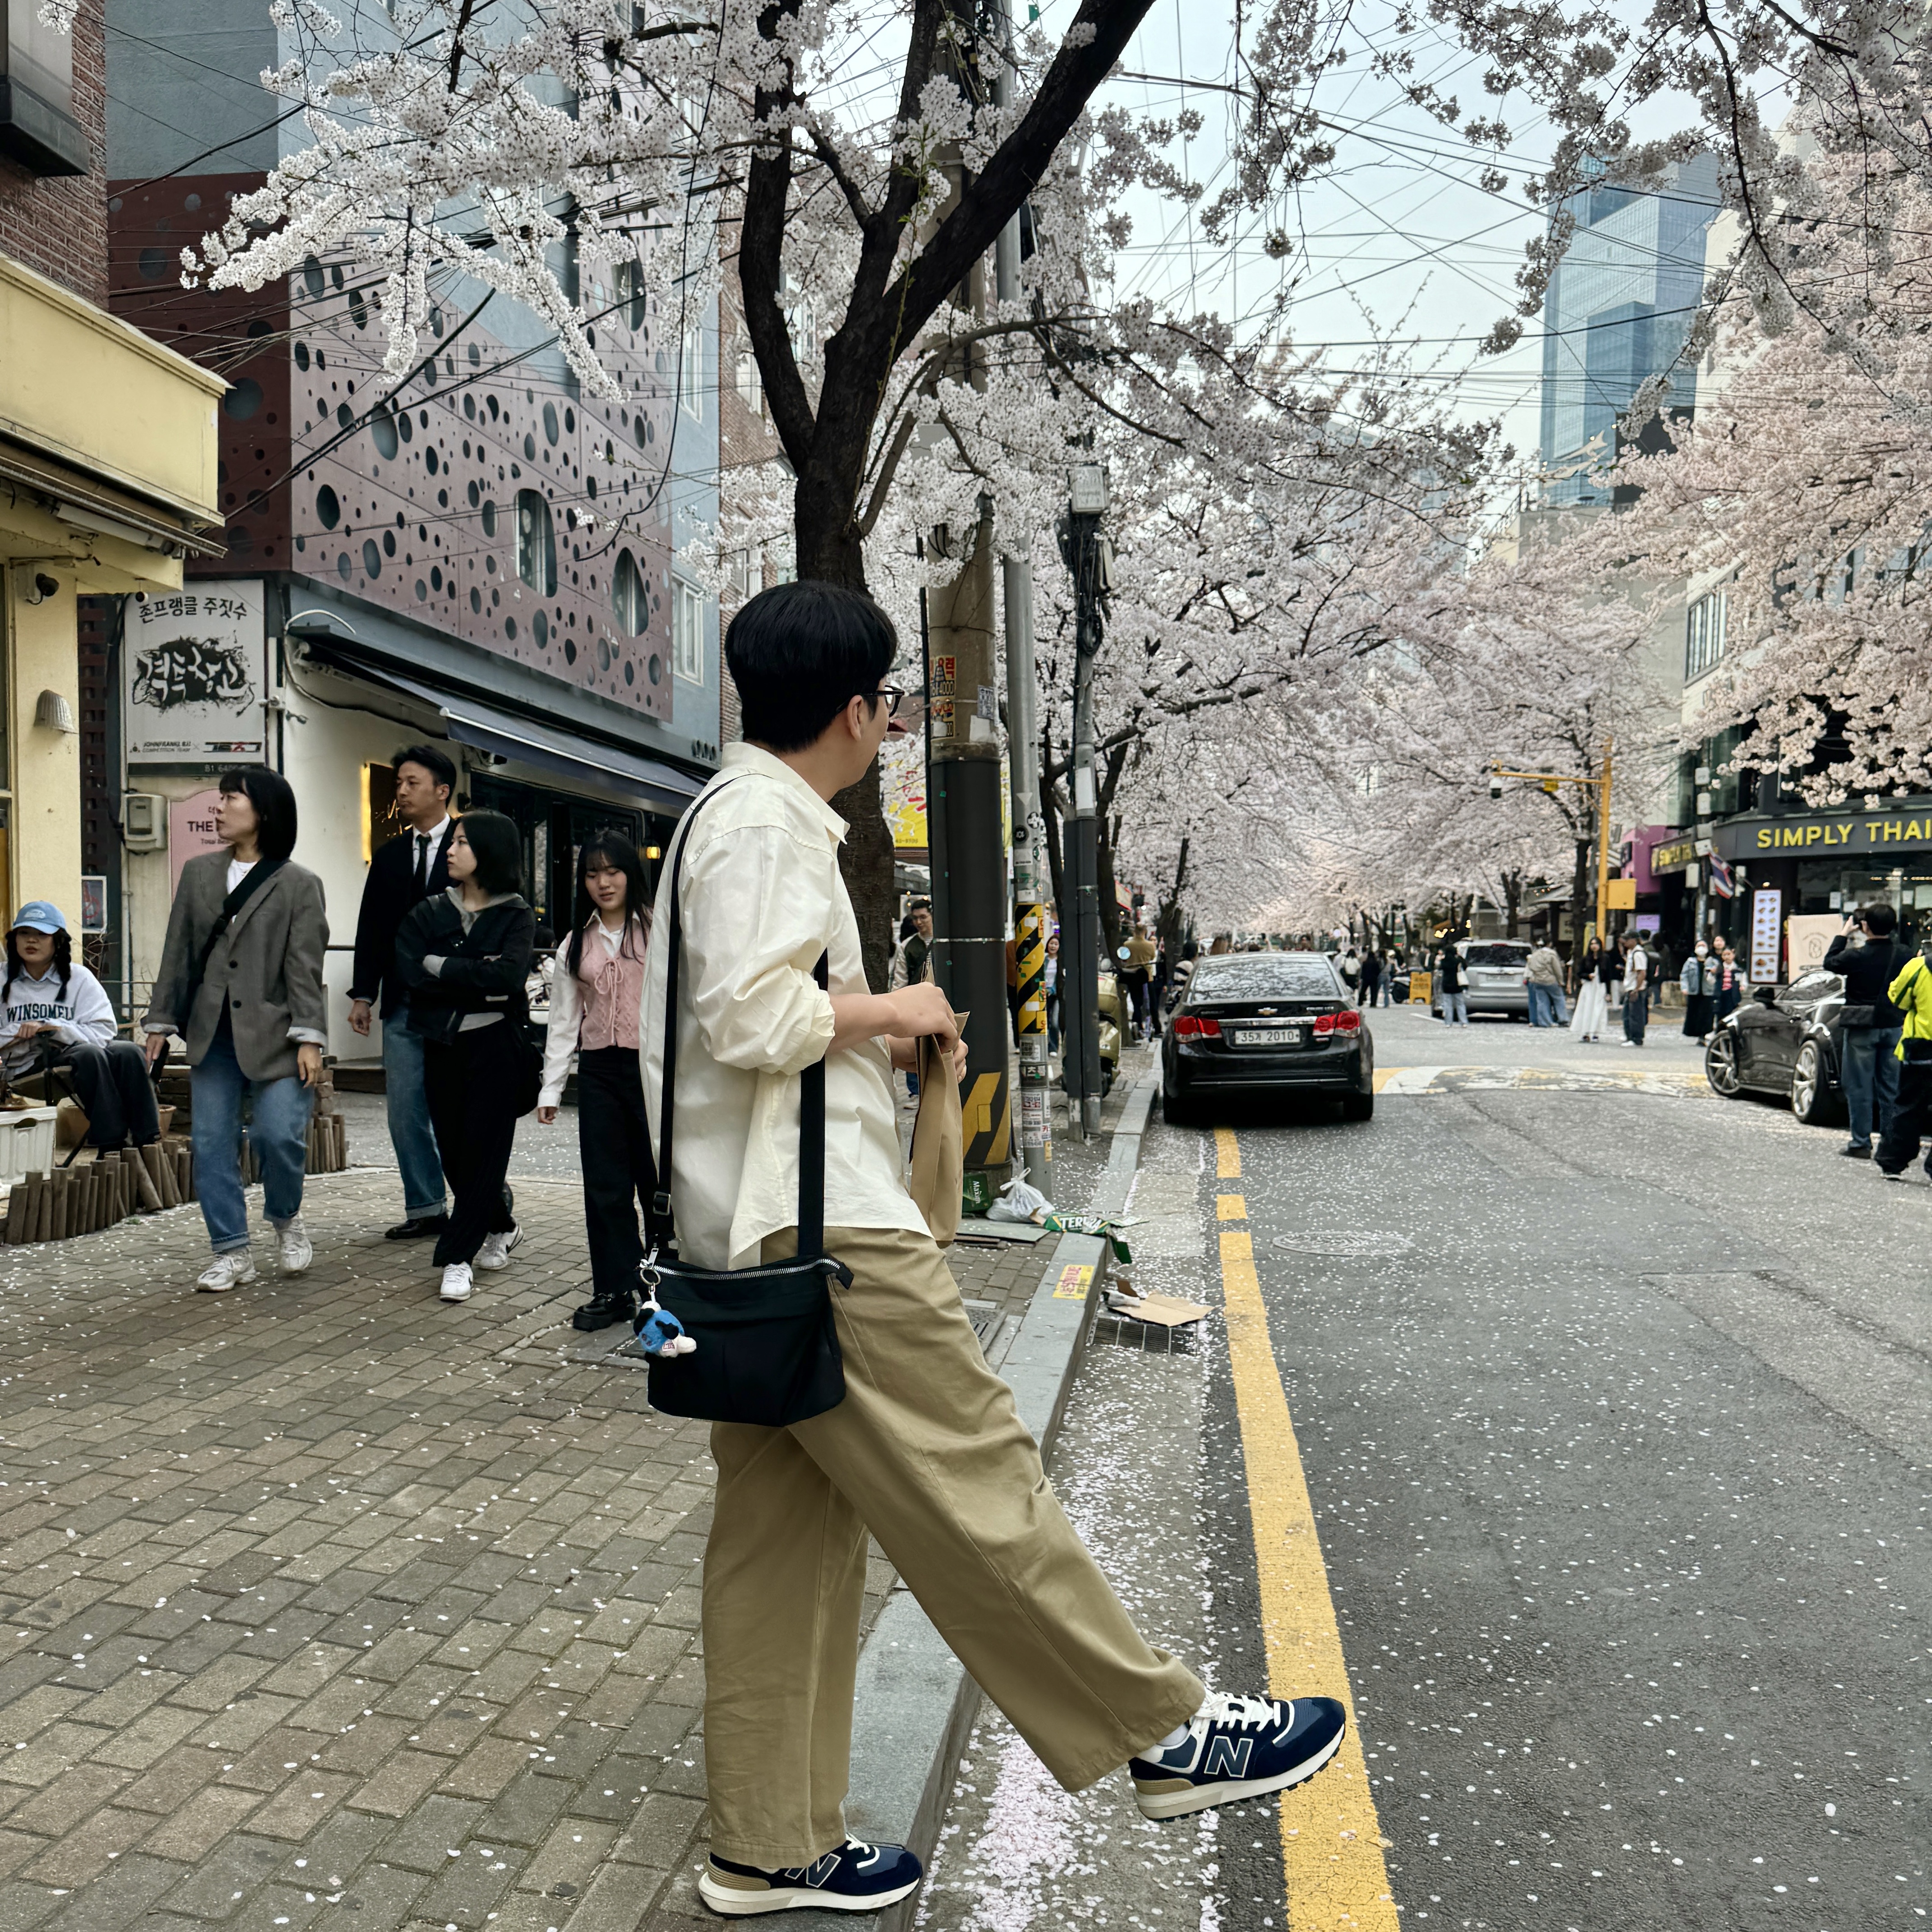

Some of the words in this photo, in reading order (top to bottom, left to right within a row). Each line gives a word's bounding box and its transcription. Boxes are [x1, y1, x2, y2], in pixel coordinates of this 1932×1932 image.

[139, 596, 198, 624] 존프랭클
[203, 597, 247, 620] 주짓수
[187, 821, 214, 832] THE
[1757, 823, 1854, 848] SIMPLY
[1865, 819, 1932, 842] THAI
[1267, 1030, 1294, 1041] 2010
[1204, 1735, 1254, 1778] N
